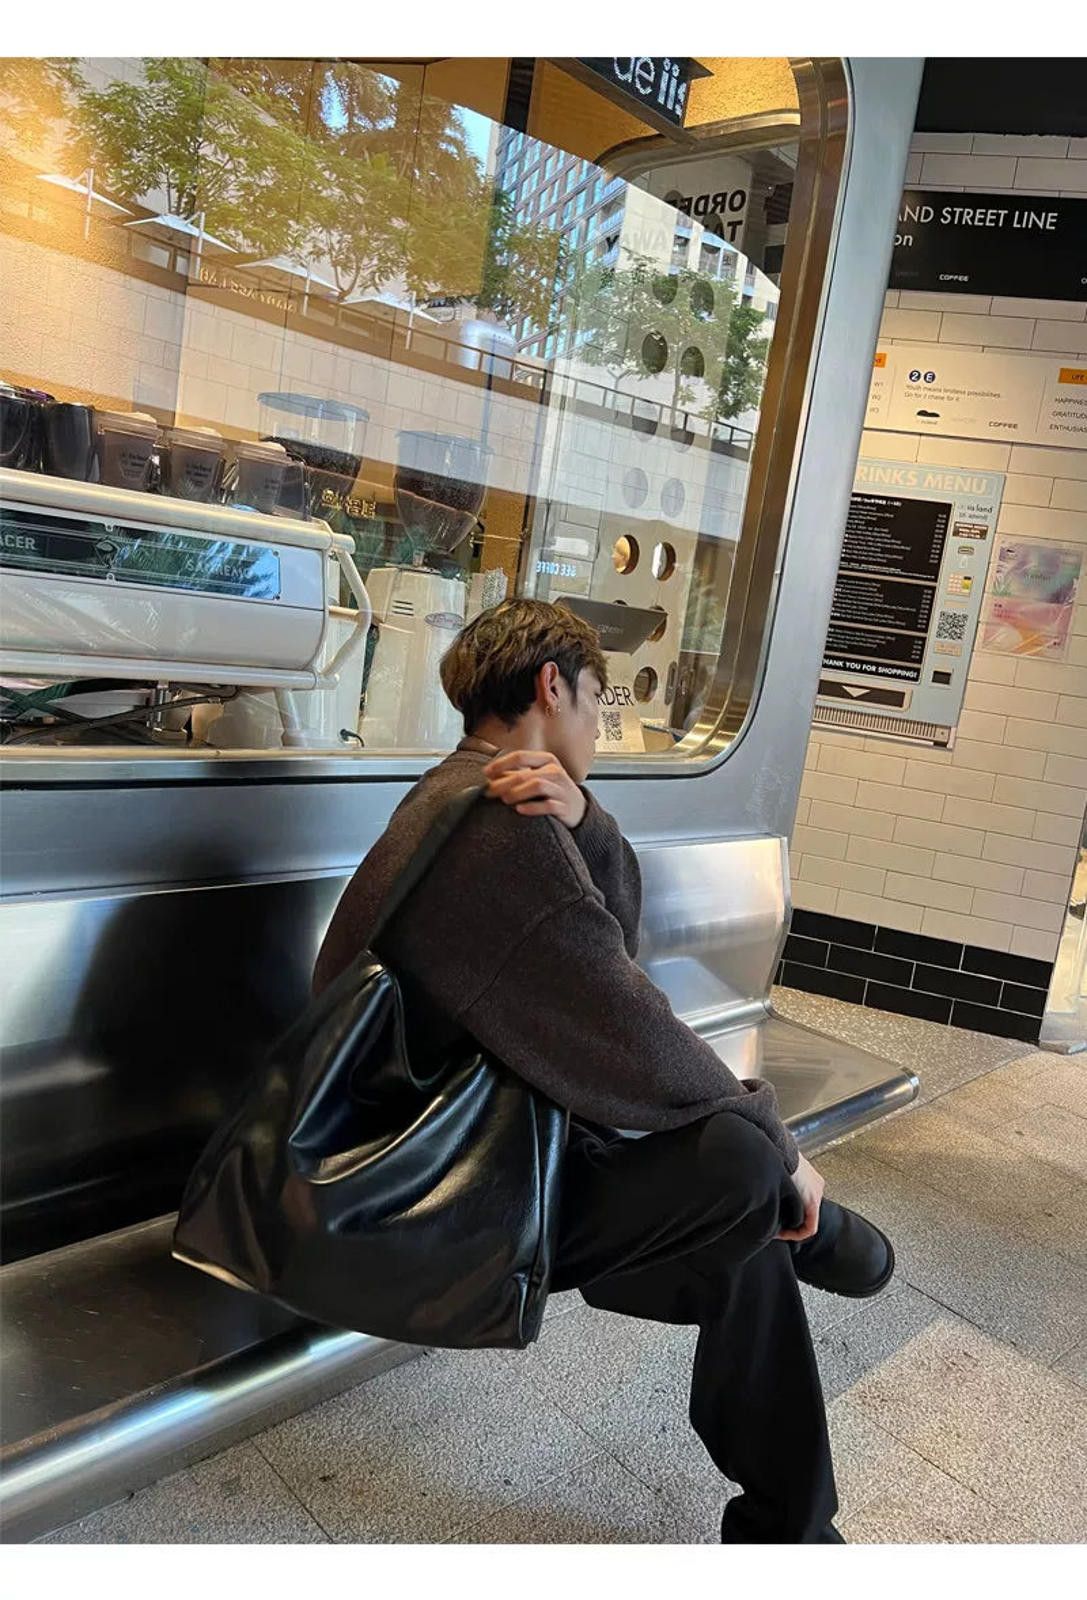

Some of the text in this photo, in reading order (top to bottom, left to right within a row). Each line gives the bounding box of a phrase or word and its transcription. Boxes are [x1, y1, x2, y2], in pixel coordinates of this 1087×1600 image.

[940, 207, 1008, 227] STREET
[1012, 211, 1059, 230] LINE
[923, 473, 987, 495] MENU
[846, 662, 861, 670] YOU
[862, 664, 877, 672] FOR
